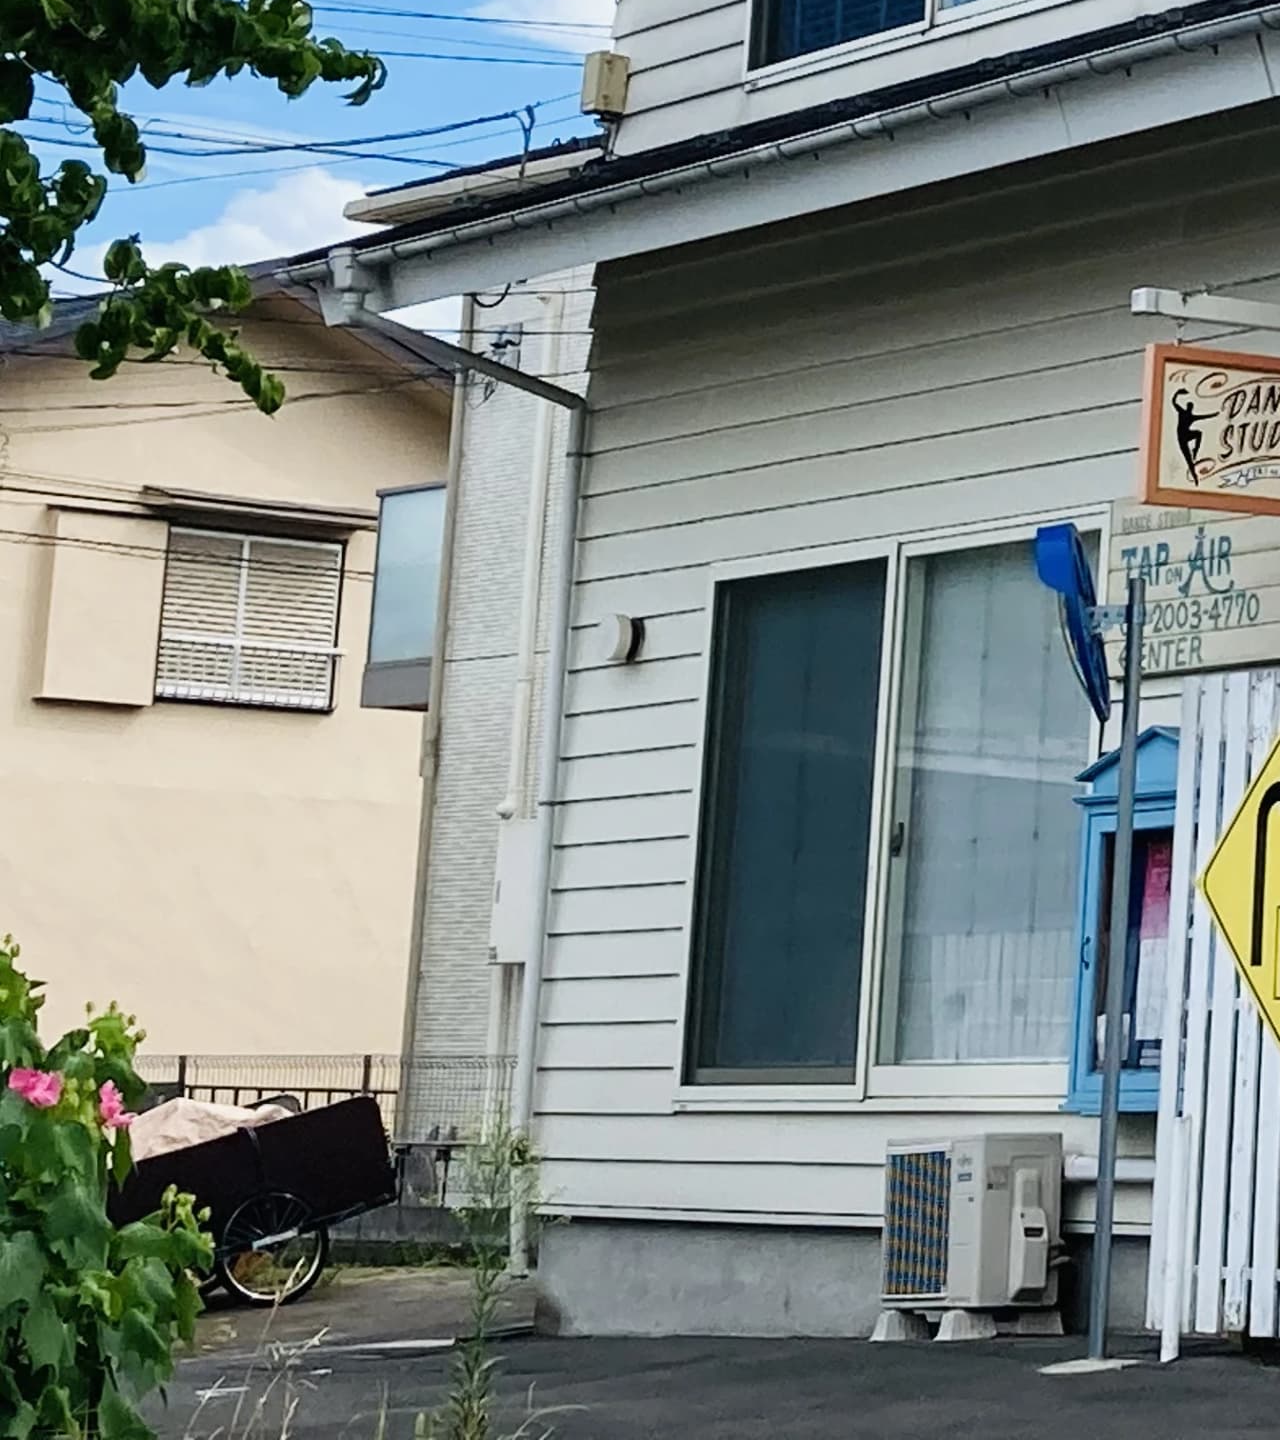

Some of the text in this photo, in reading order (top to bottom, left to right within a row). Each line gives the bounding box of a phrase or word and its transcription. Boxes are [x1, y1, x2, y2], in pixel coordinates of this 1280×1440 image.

[1121, 535, 1235, 597] TAP ON AIR
